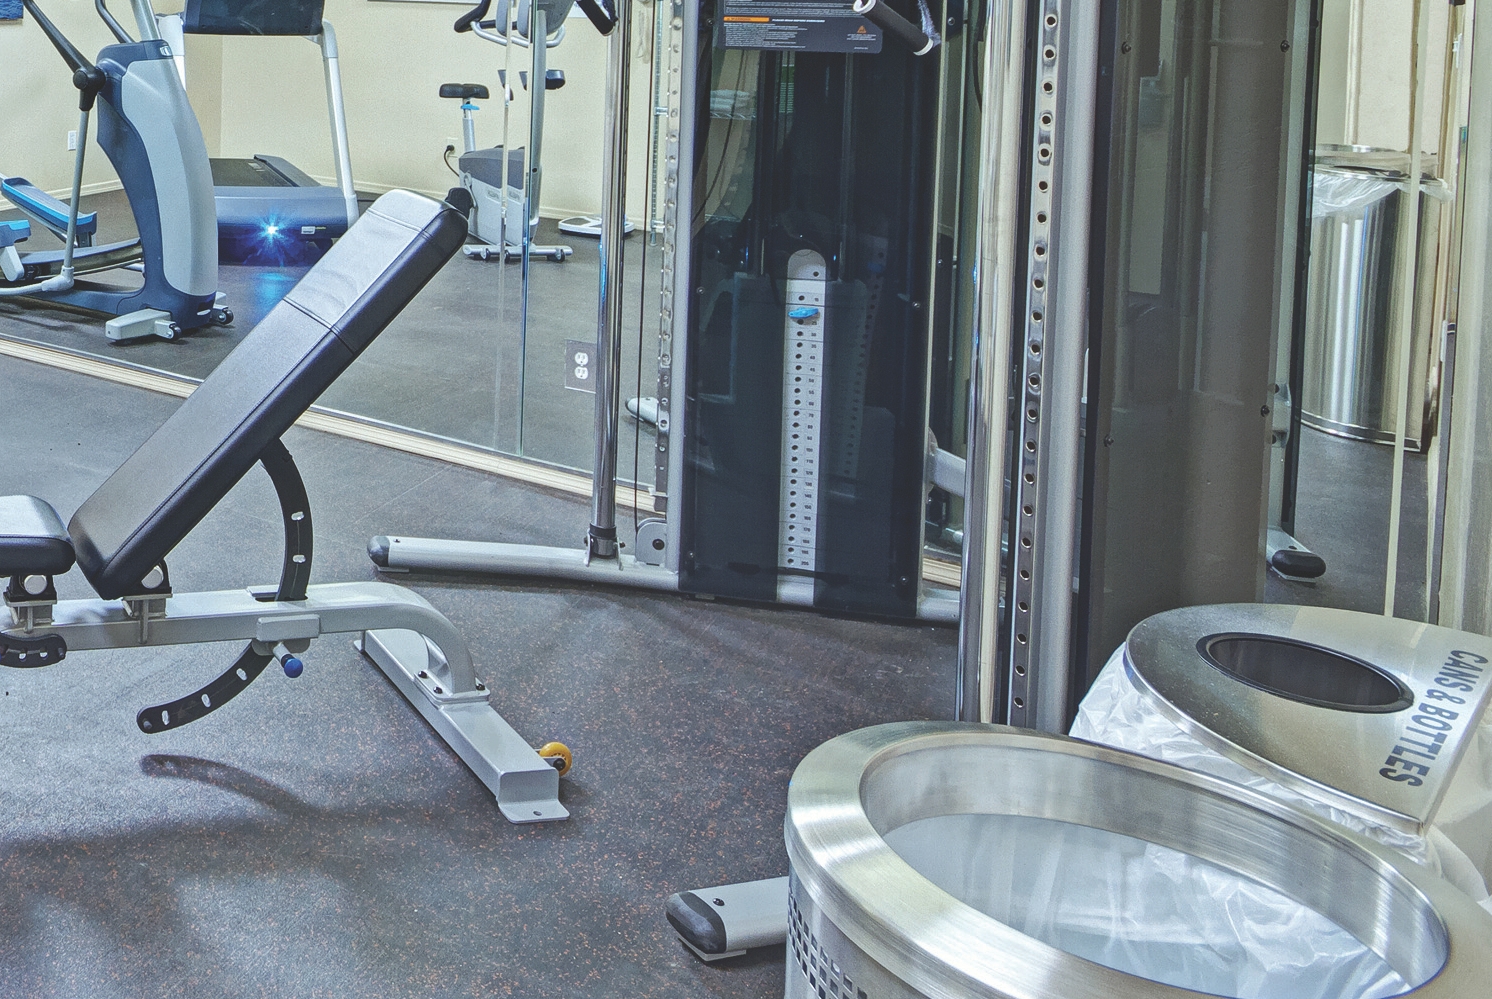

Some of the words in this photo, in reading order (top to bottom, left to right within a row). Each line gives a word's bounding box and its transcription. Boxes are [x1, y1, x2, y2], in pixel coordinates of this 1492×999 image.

[1434, 649, 1489, 692] CANS
[1425, 688, 1466, 705] &
[1378, 702, 1460, 787] BOTTLES
